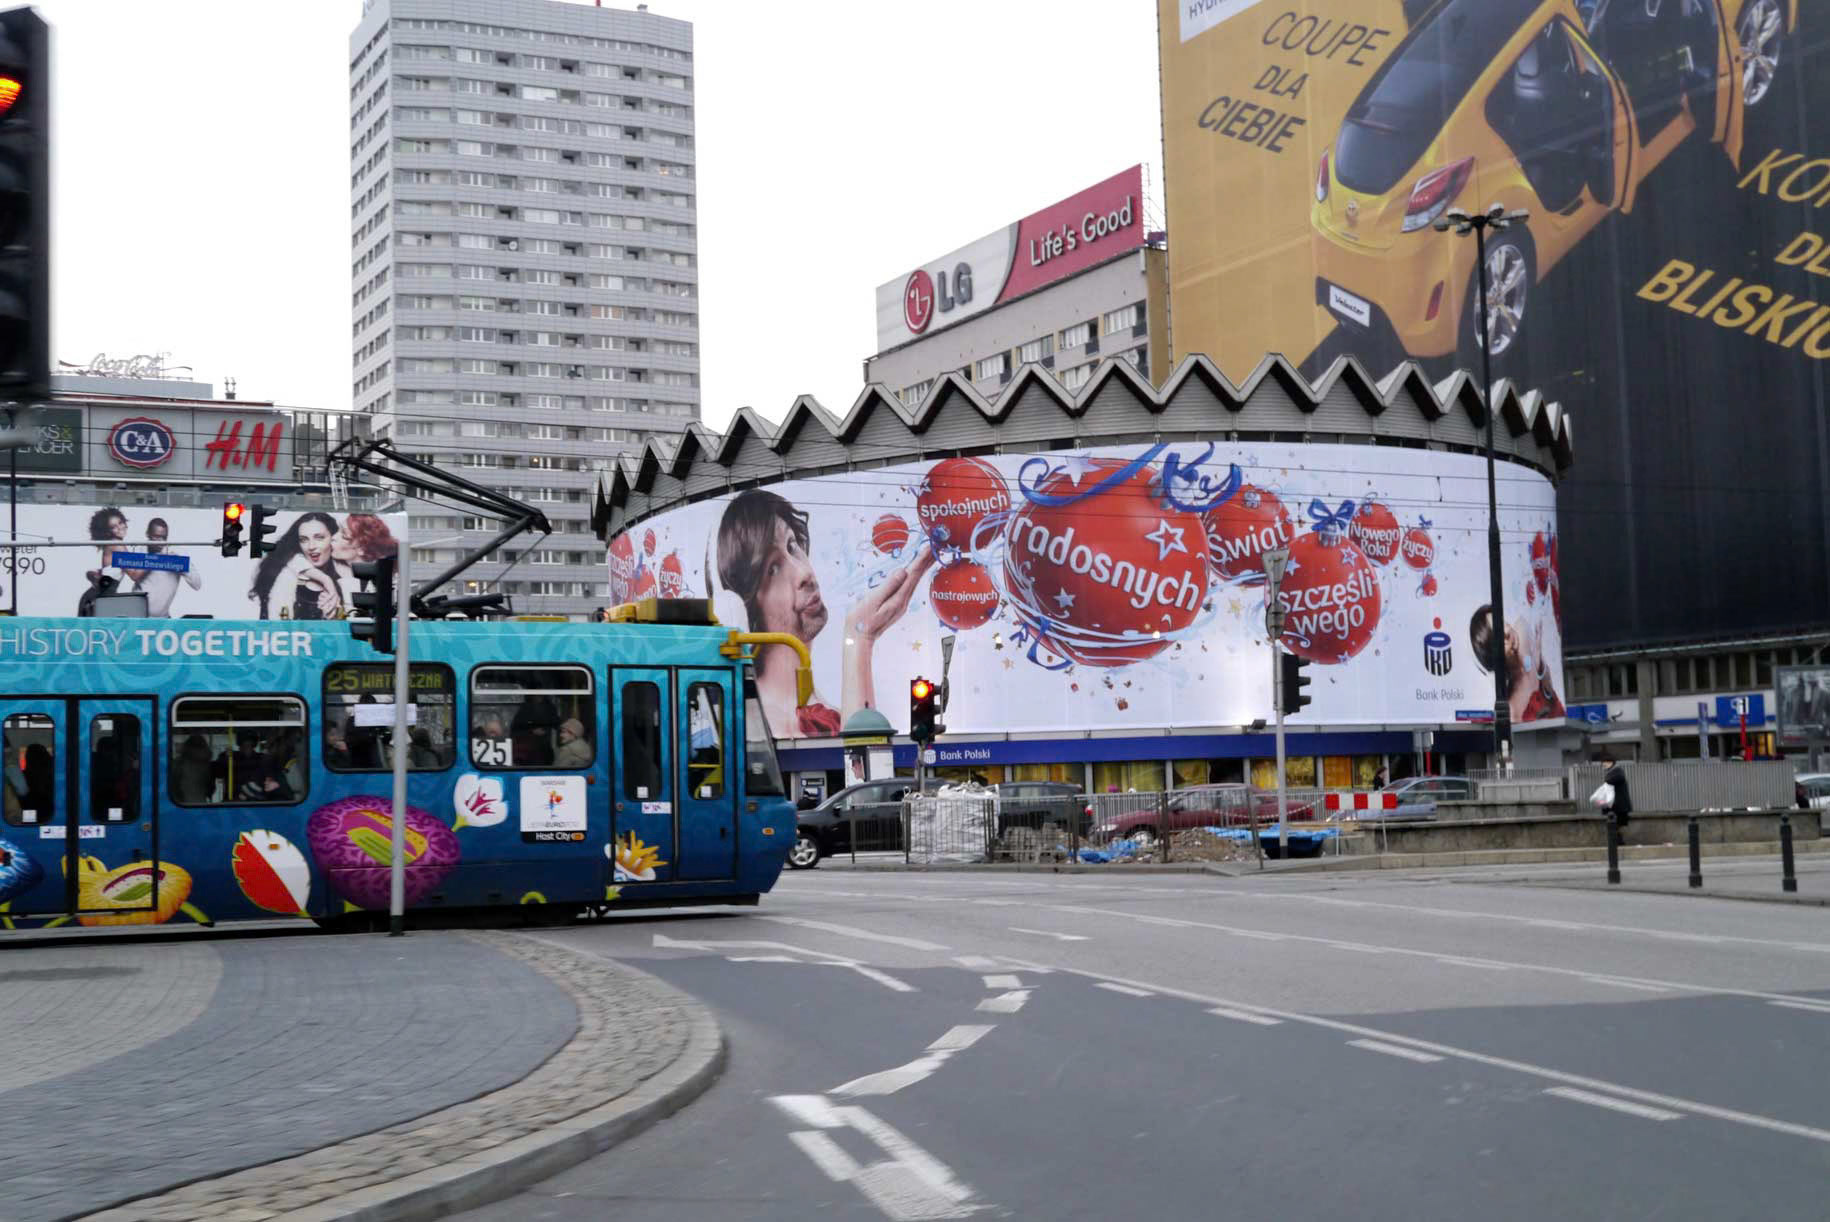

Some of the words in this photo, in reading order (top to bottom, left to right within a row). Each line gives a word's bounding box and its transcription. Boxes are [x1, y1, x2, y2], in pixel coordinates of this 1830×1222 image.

[1262, 11, 1391, 66] COUPE
[1254, 65, 1309, 100] DLA
[1198, 96, 1307, 153] CIEBIE
[1736, 149, 1830, 208] KO
[937, 262, 972, 312] LG
[1030, 224, 1077, 267] Life's
[1081, 196, 1134, 243] Good
[120, 430, 165, 454] C&A
[920, 490, 1008, 522] spokojnych
[1351, 521, 1399, 546] Nowego
[1361, 539, 1390, 557] Roku
[1402, 536, 1433, 563] życzy
[1012, 517, 1200, 611] radosnych
[931, 589, 998, 604] nastrojowych
[1292, 604, 1365, 640] wego
[0, 628, 126, 656] HISTORY
[135, 629, 313, 657] TOGETHER
[327, 670, 360, 691] 25
[1416, 688, 1438, 700] Bank
[1440, 688, 1464, 701] Polski
[477, 739, 506, 767] 25
[940, 750, 962, 761] Bank
[964, 749, 990, 760] Polski
[535, 831, 555, 841] Host
[555, 831, 571, 842] City
